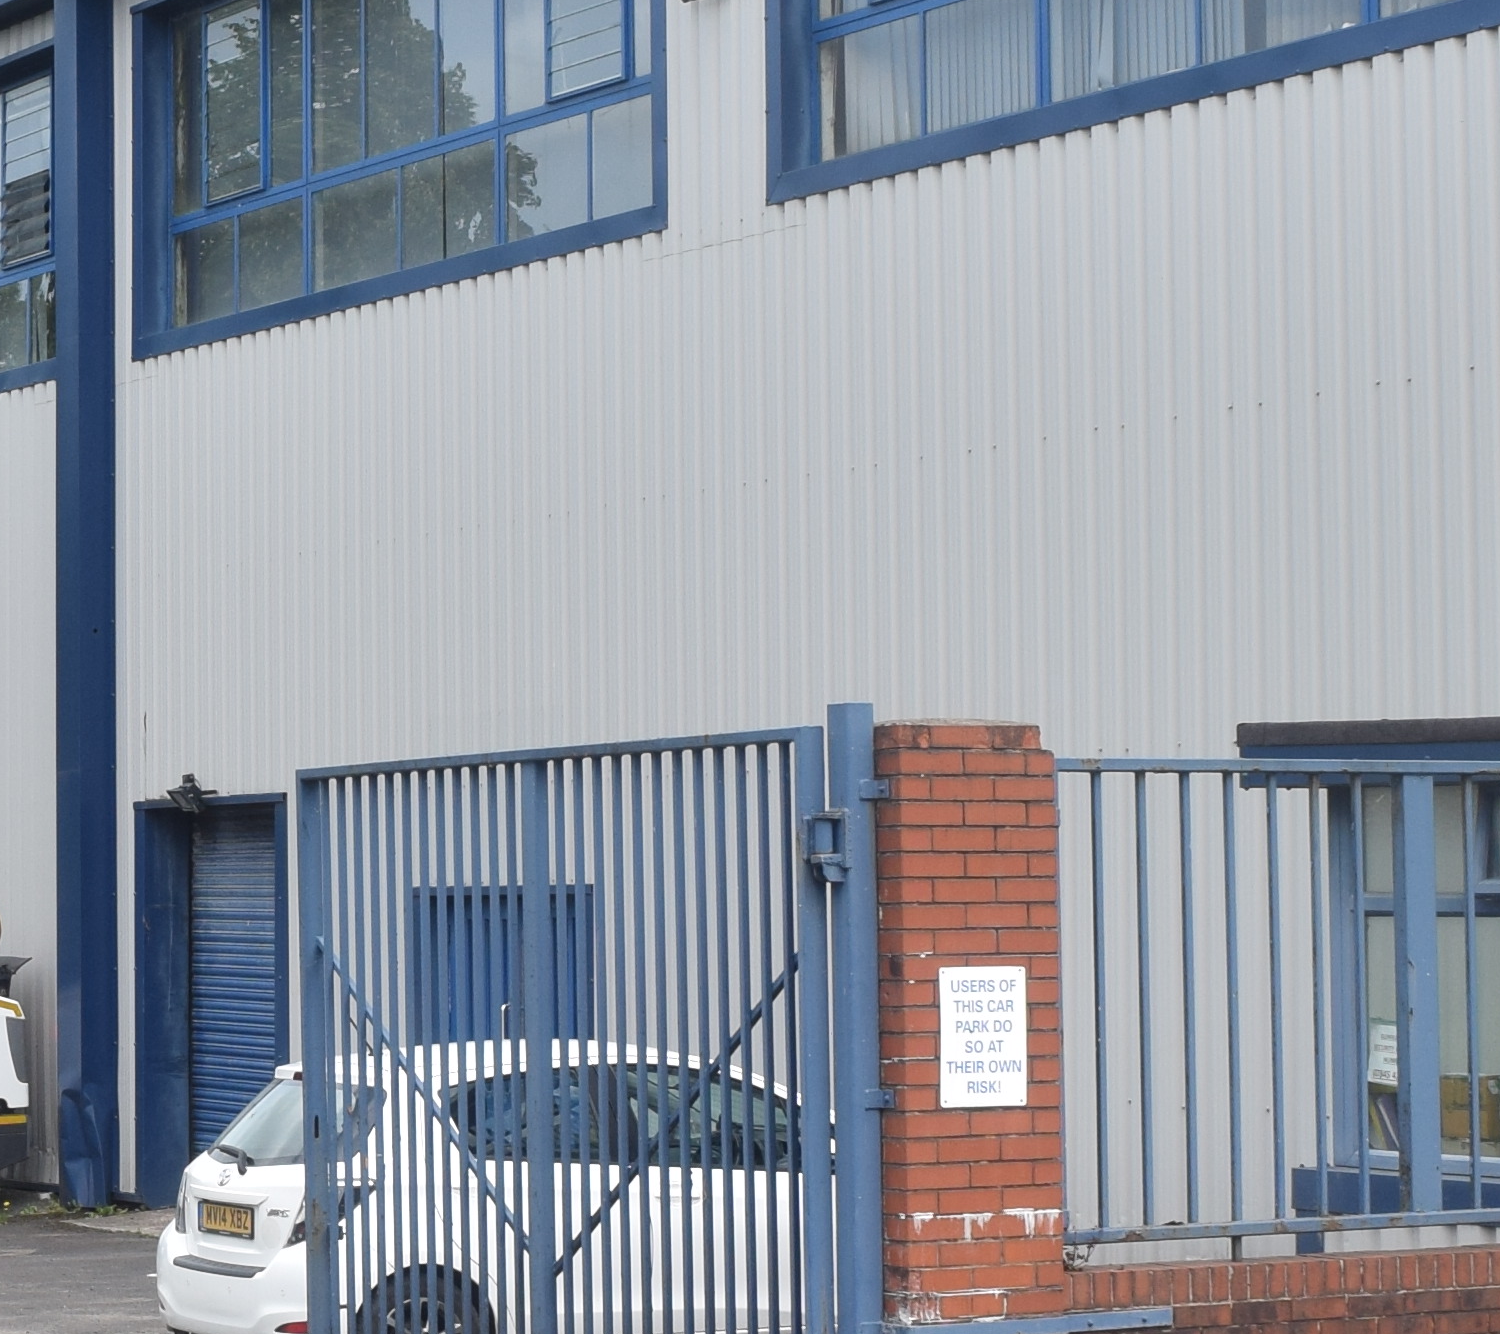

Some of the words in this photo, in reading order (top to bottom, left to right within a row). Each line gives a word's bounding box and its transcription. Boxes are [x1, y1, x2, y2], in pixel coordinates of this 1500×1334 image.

[950, 979, 995, 993] USERS
[999, 979, 1017, 993] OF
[953, 999, 984, 1013] THIS
[987, 999, 1014, 1013] CAR
[955, 1020, 989, 1033] PARK
[993, 1019, 1013, 1032] DO
[964, 1041, 984, 1054] SO
[987, 1039, 1004, 1053] AT
[946, 1061, 985, 1074] THEIR
[988, 1060, 1022, 1073] OWN
[966, 1080, 1001, 1094] RISK!
[206, 1205, 227, 1227] MV14
[229, 1208, 249, 1230] XBZ
